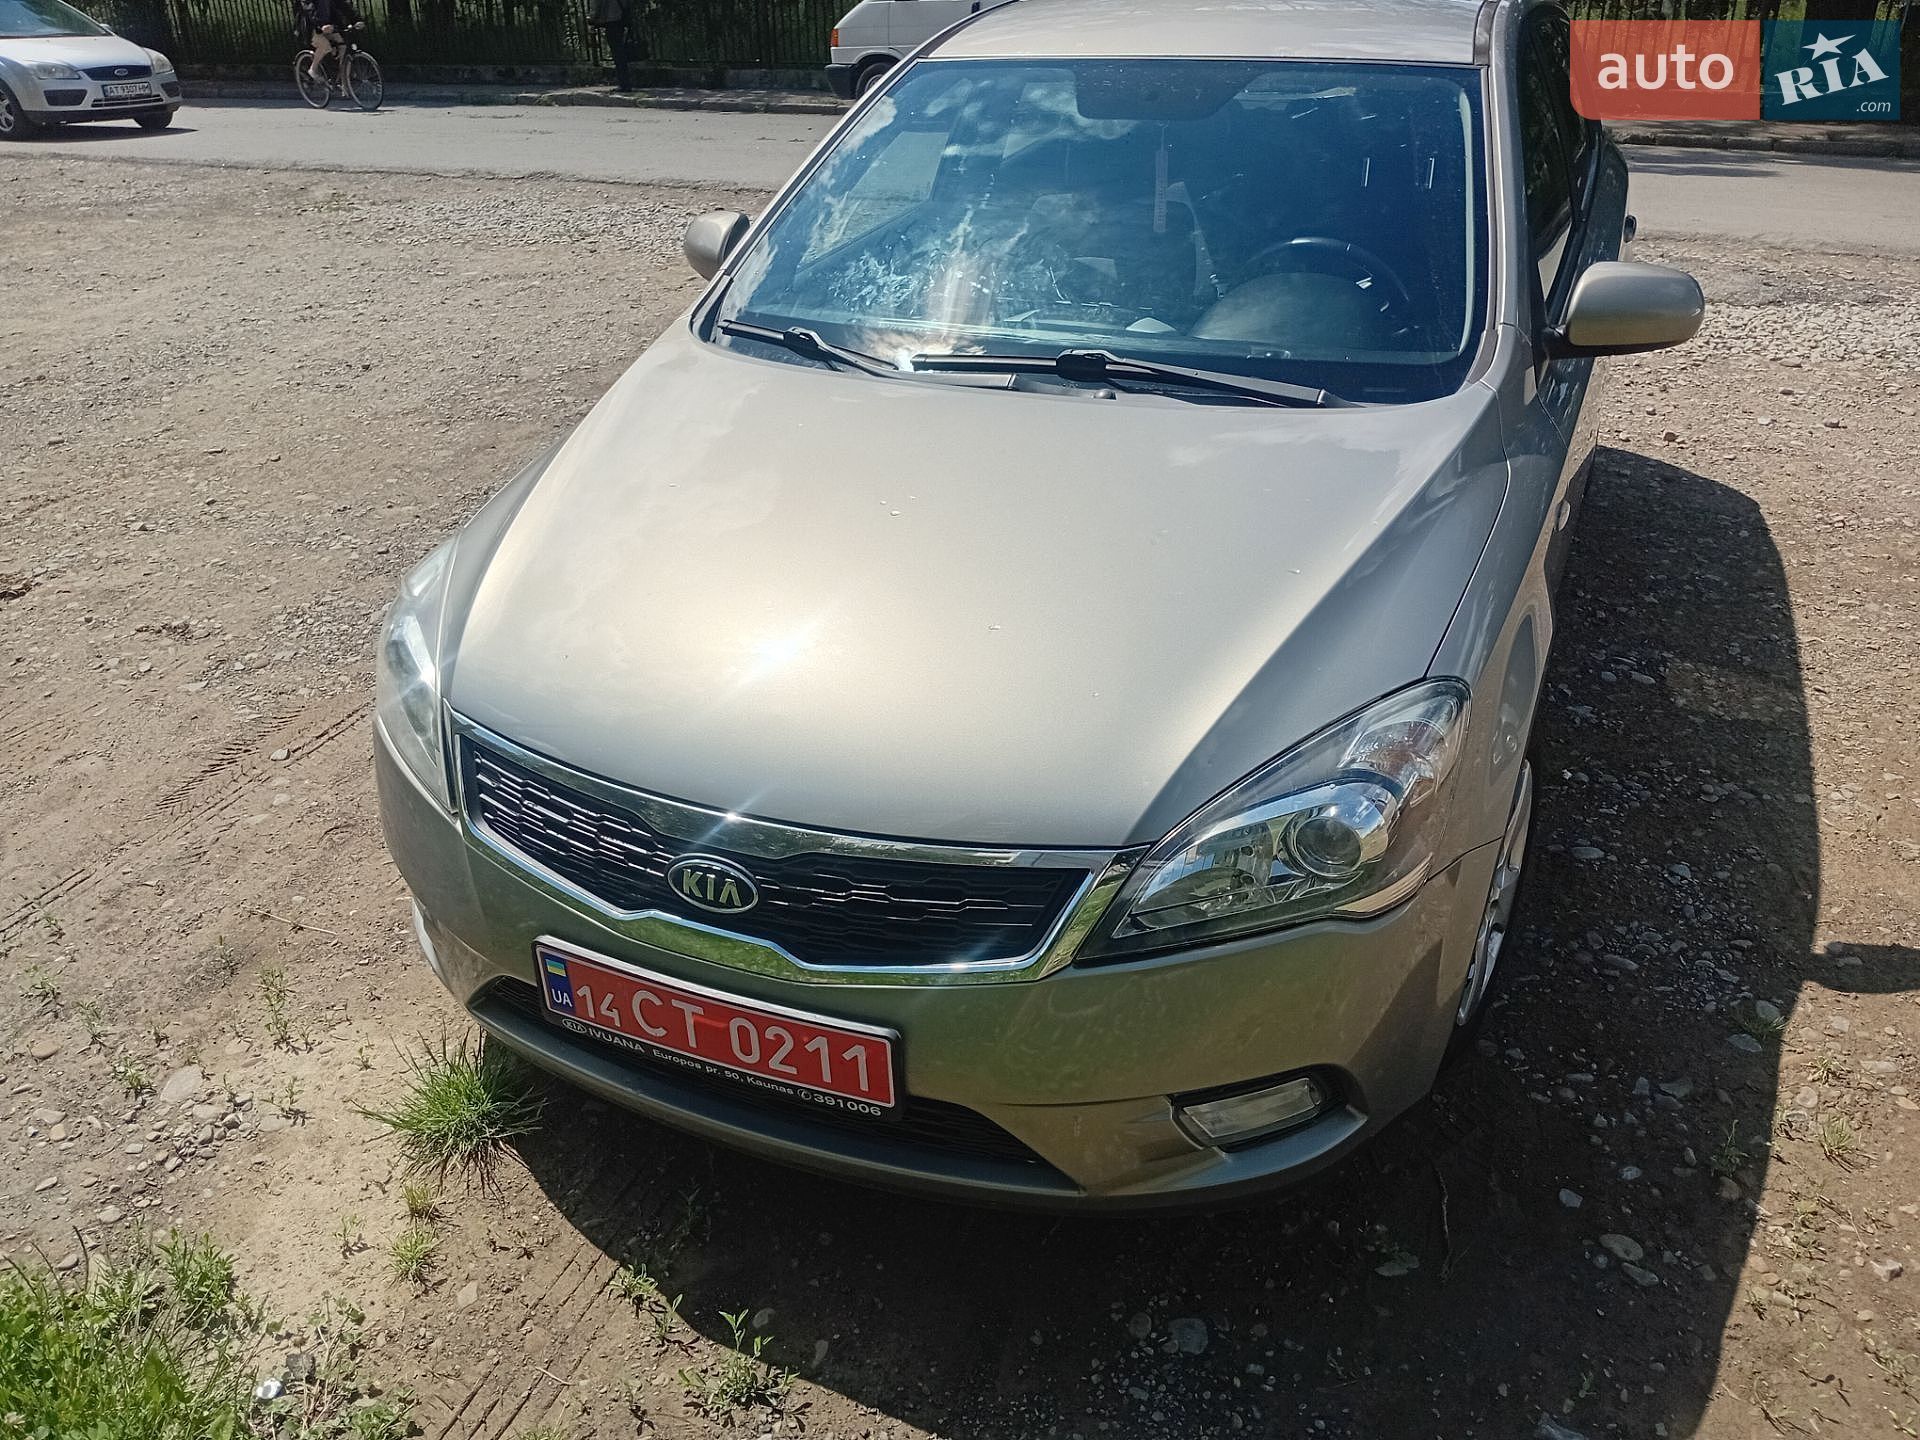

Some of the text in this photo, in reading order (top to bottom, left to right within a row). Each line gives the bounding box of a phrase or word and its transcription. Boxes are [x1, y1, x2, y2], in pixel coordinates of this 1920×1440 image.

[682, 868, 742, 907] KIA
[551, 988, 573, 1008] UA
[729, 1017, 870, 1092] 0211
[652, 1048, 702, 1070] Europos
[705, 1064, 721, 1076] pr.
[724, 1070, 744, 1083] 50,
[746, 1076, 794, 1096] Kaunas
[813, 1093, 882, 1117] 391006
